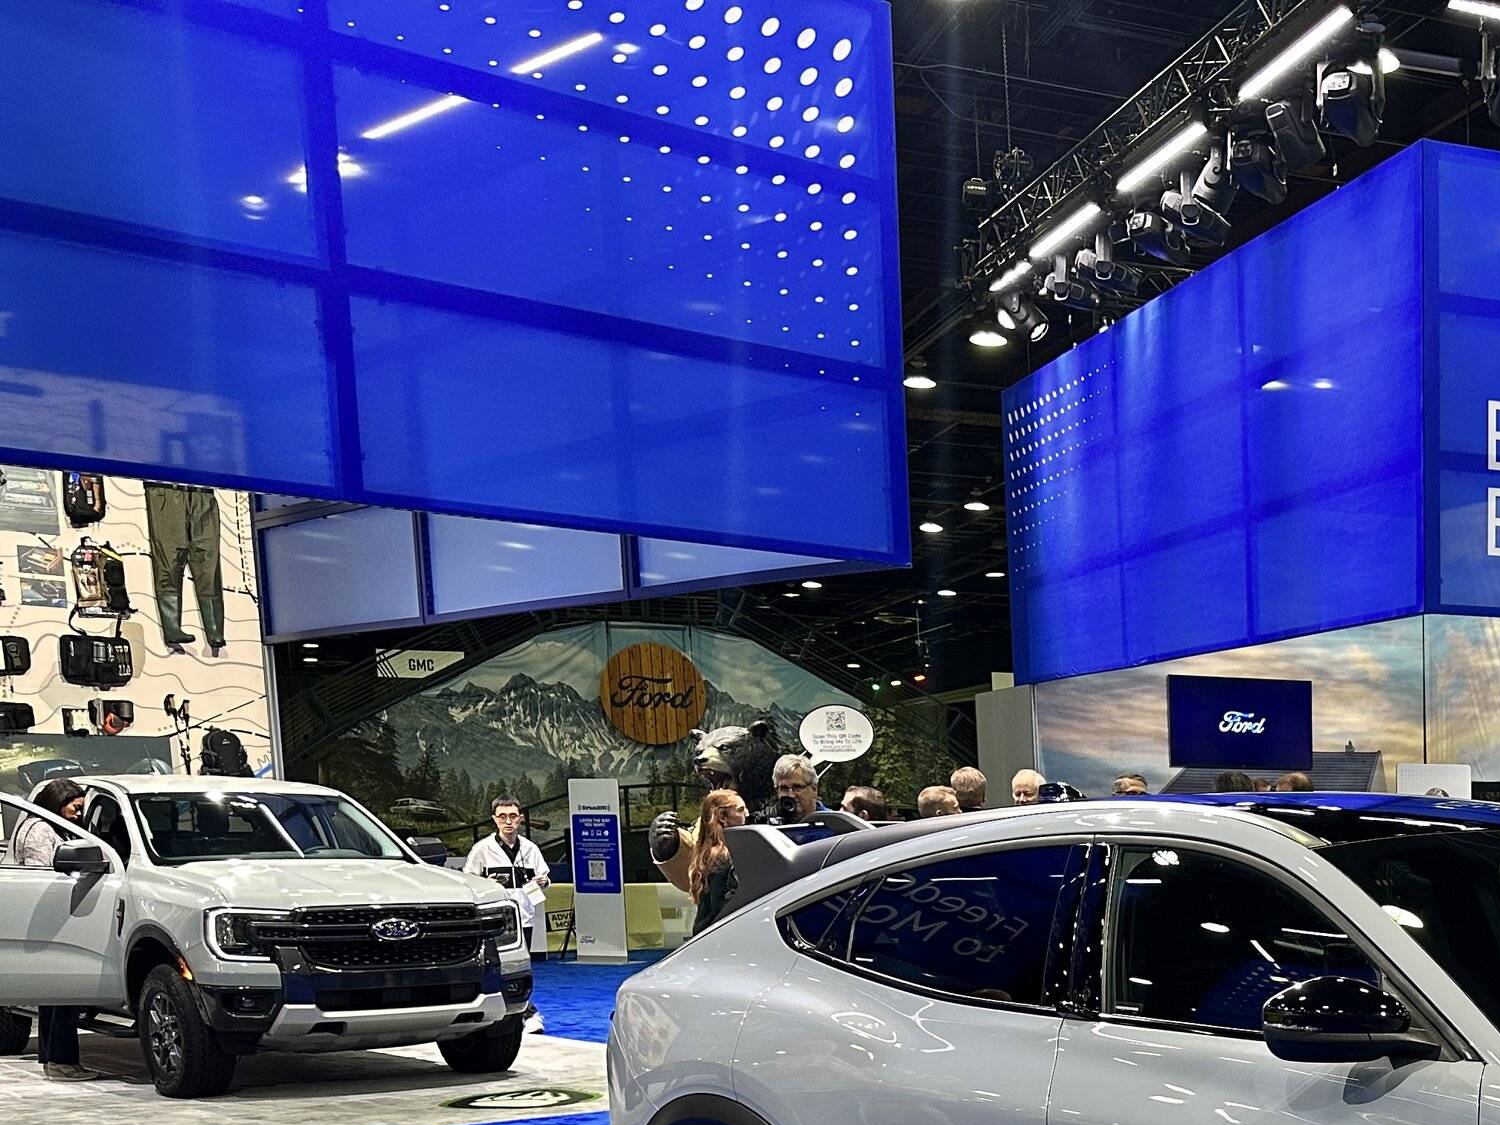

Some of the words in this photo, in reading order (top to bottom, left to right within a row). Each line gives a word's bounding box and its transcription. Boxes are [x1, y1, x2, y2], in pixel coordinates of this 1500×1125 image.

[408, 658, 435, 672] GMC
[610, 675, 695, 709] Ford
[1218, 710, 1266, 734] Ford
